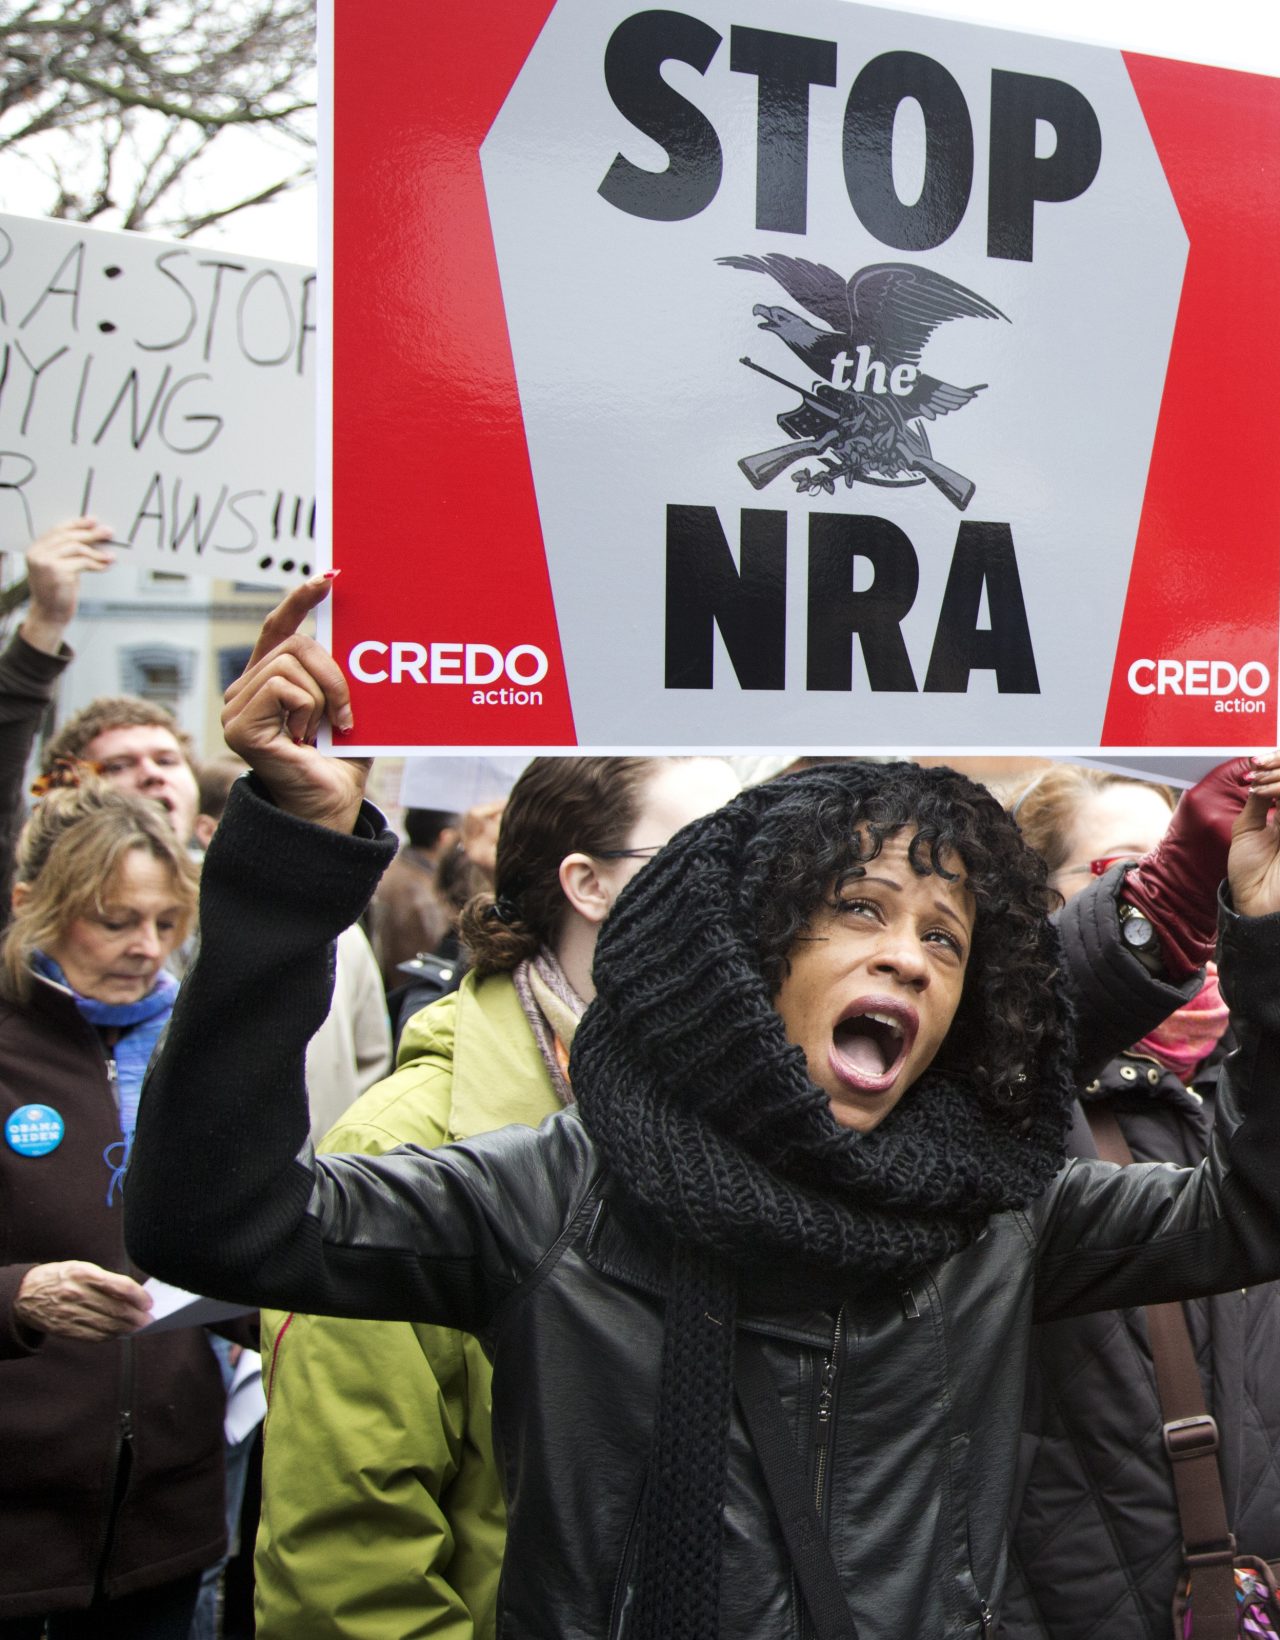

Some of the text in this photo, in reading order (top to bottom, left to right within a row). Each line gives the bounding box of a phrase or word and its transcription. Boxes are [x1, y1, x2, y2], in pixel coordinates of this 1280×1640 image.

[597, 9, 1102, 262] STOP
[830, 345, 918, 396] the
[0, 339, 223, 455] YING
[664, 503, 1041, 694] NRA
[348, 640, 549, 686] CREDO
[1127, 658, 1271, 697] CREDO
[471, 688, 543, 705] action
[1214, 698, 1266, 713] action
[9, 1122, 60, 1134] OBAMA
[11, 1131, 60, 1144] BIDEN
